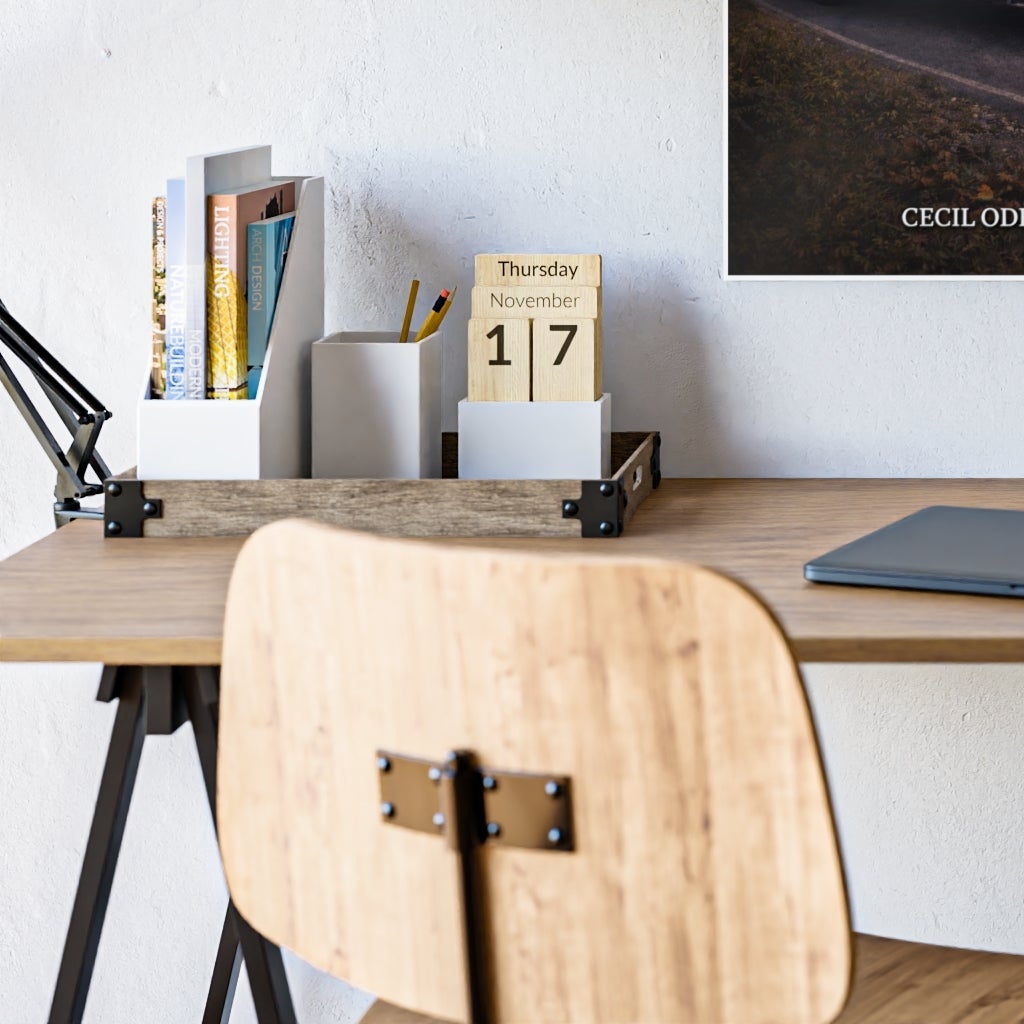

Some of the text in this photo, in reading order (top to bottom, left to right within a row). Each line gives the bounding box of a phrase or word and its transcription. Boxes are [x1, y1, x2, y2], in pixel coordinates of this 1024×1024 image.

[901, 205, 976, 228] CECIL
[214, 206, 230, 298] LIGHTING
[251, 228, 264, 312] ARCH DESIGN
[498, 260, 578, 280] Thursday
[491, 293, 579, 309] November
[188, 329, 203, 399] MODERN
